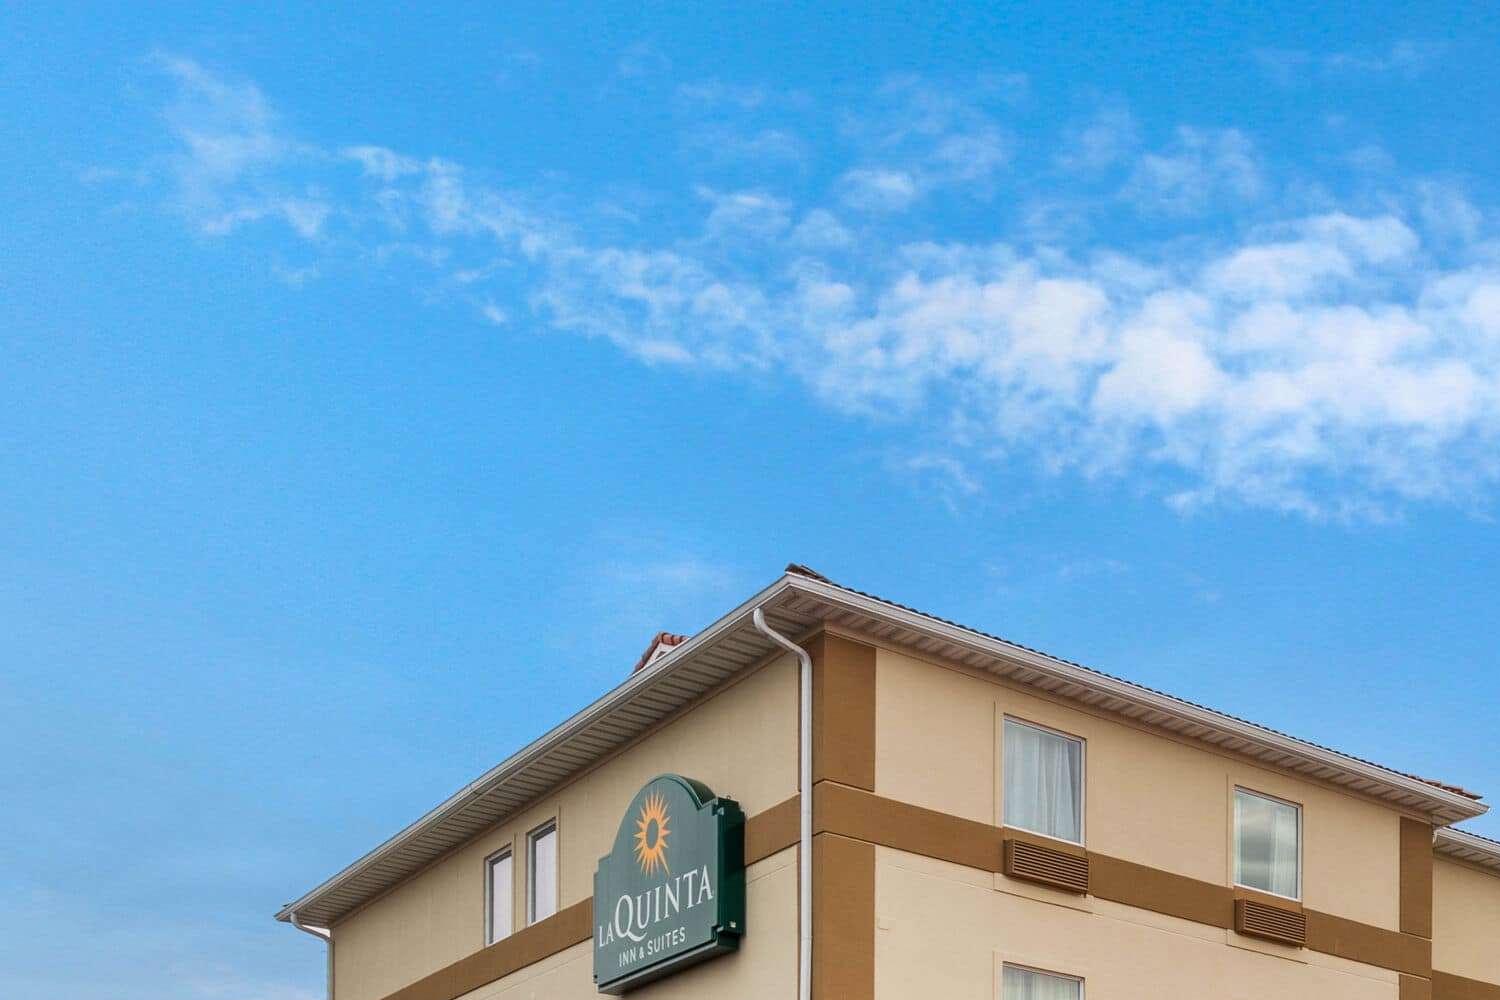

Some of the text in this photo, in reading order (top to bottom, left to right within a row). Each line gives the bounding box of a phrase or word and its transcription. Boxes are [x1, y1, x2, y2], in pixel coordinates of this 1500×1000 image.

[598, 864, 714, 948] LA QUINTA
[618, 926, 686, 968] INN & SUITES
